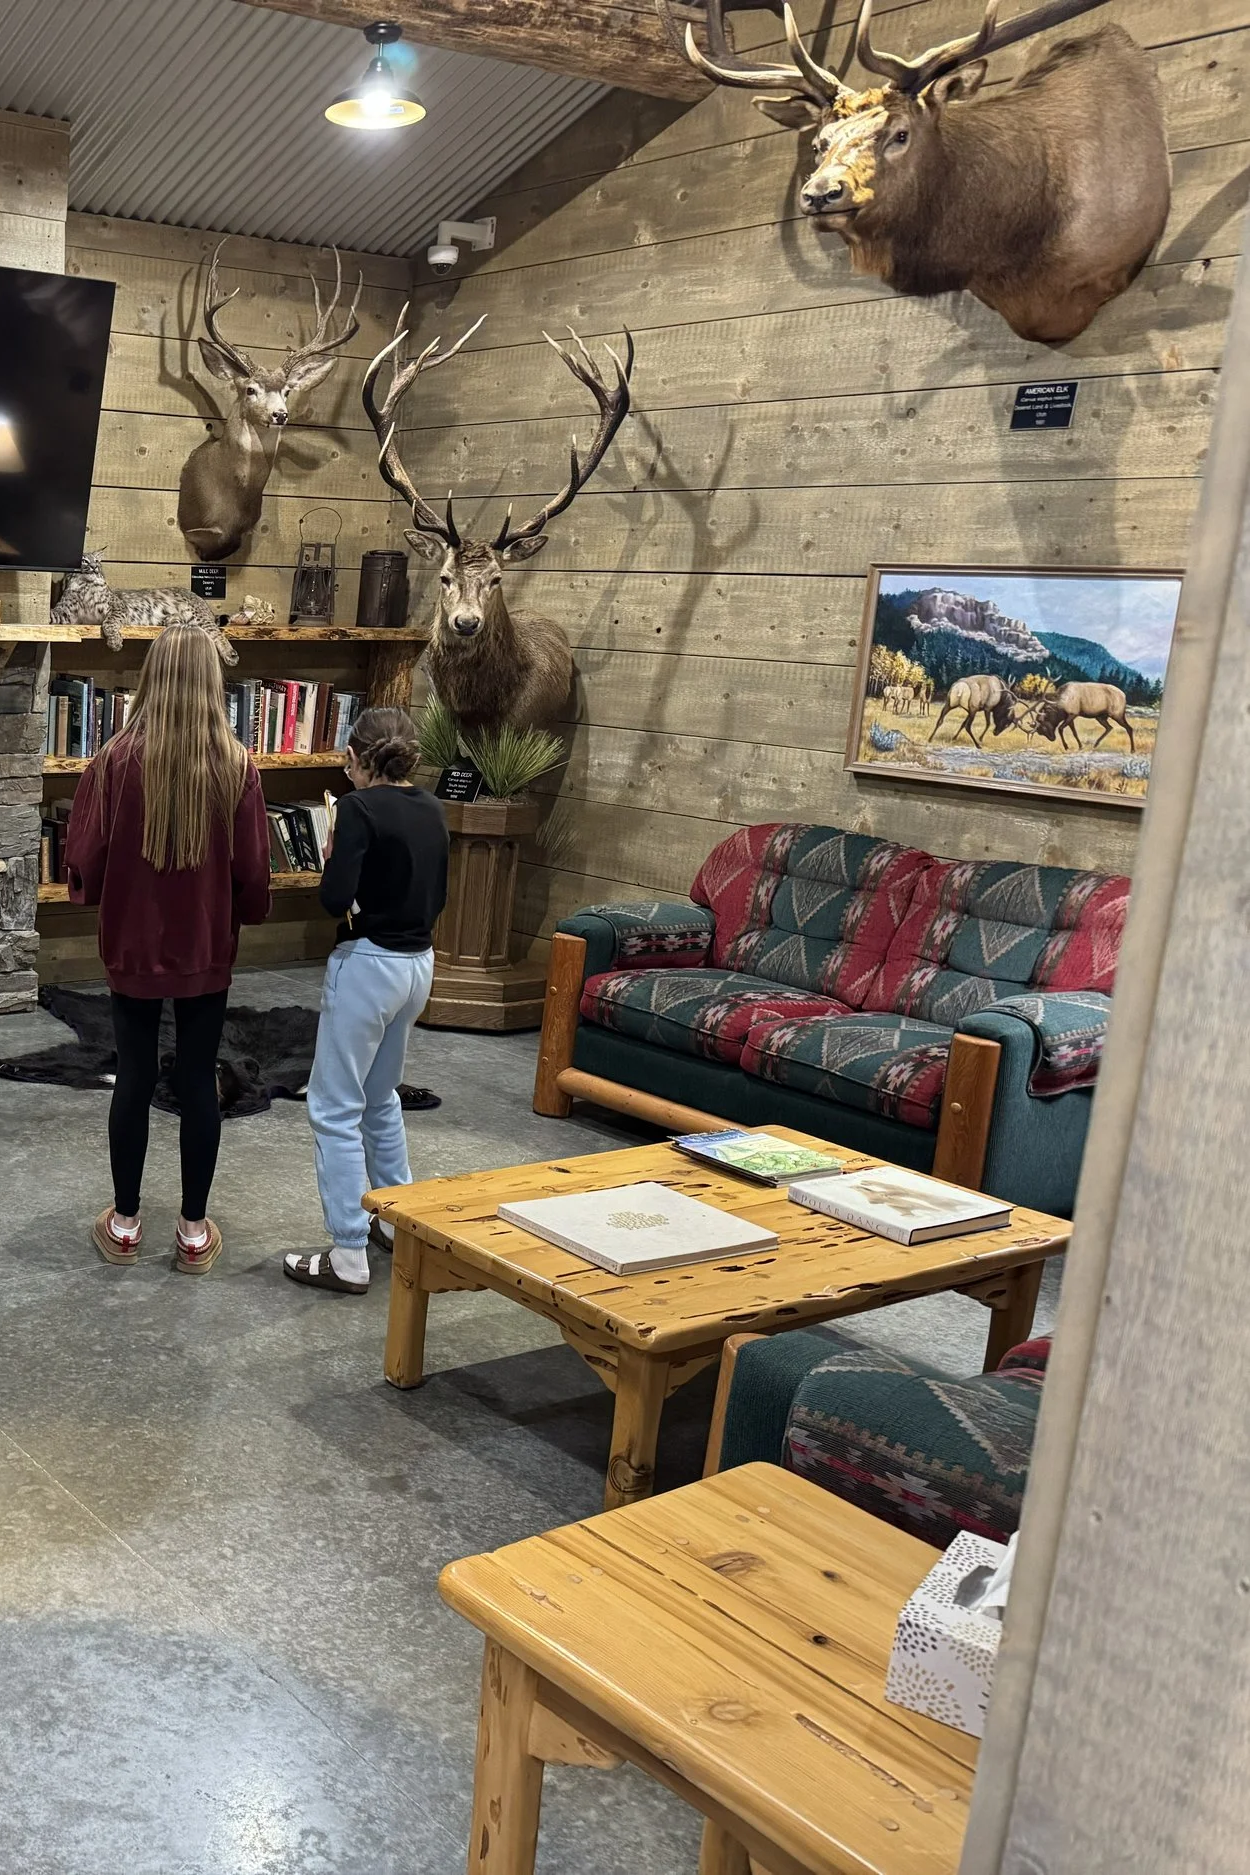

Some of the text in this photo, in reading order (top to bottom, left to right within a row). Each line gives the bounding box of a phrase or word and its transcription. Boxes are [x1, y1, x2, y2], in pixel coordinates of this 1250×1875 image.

[1025, 385, 1069, 395] AMERICAN ELK
[801, 1195, 890, 1235] POLAR DANCE
